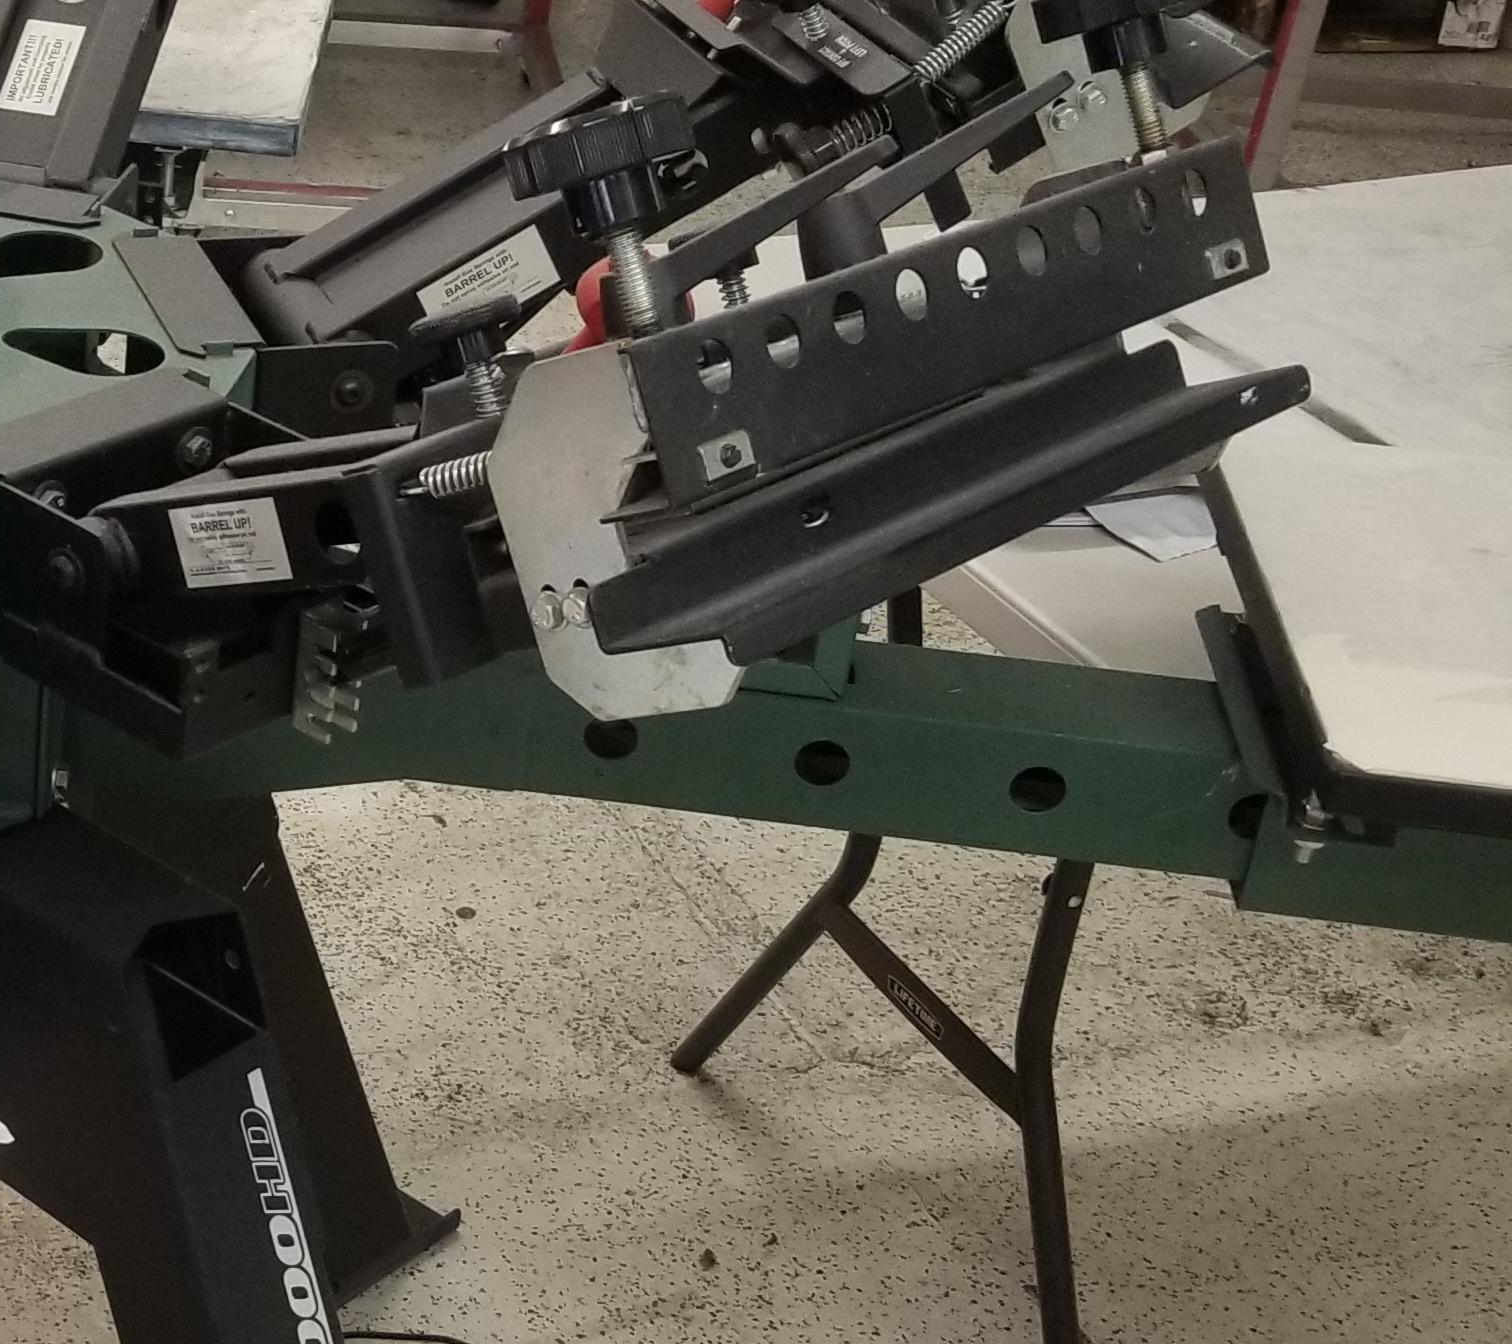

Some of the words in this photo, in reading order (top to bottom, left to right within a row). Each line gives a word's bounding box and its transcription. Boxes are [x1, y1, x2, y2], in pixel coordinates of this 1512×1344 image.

[444, 267, 493, 298] BARREL
[492, 252, 515, 270] UP!
[190, 518, 234, 534] BARREL
[233, 516, 252, 530] UP!
[893, 982, 939, 1032] LIFETIME
